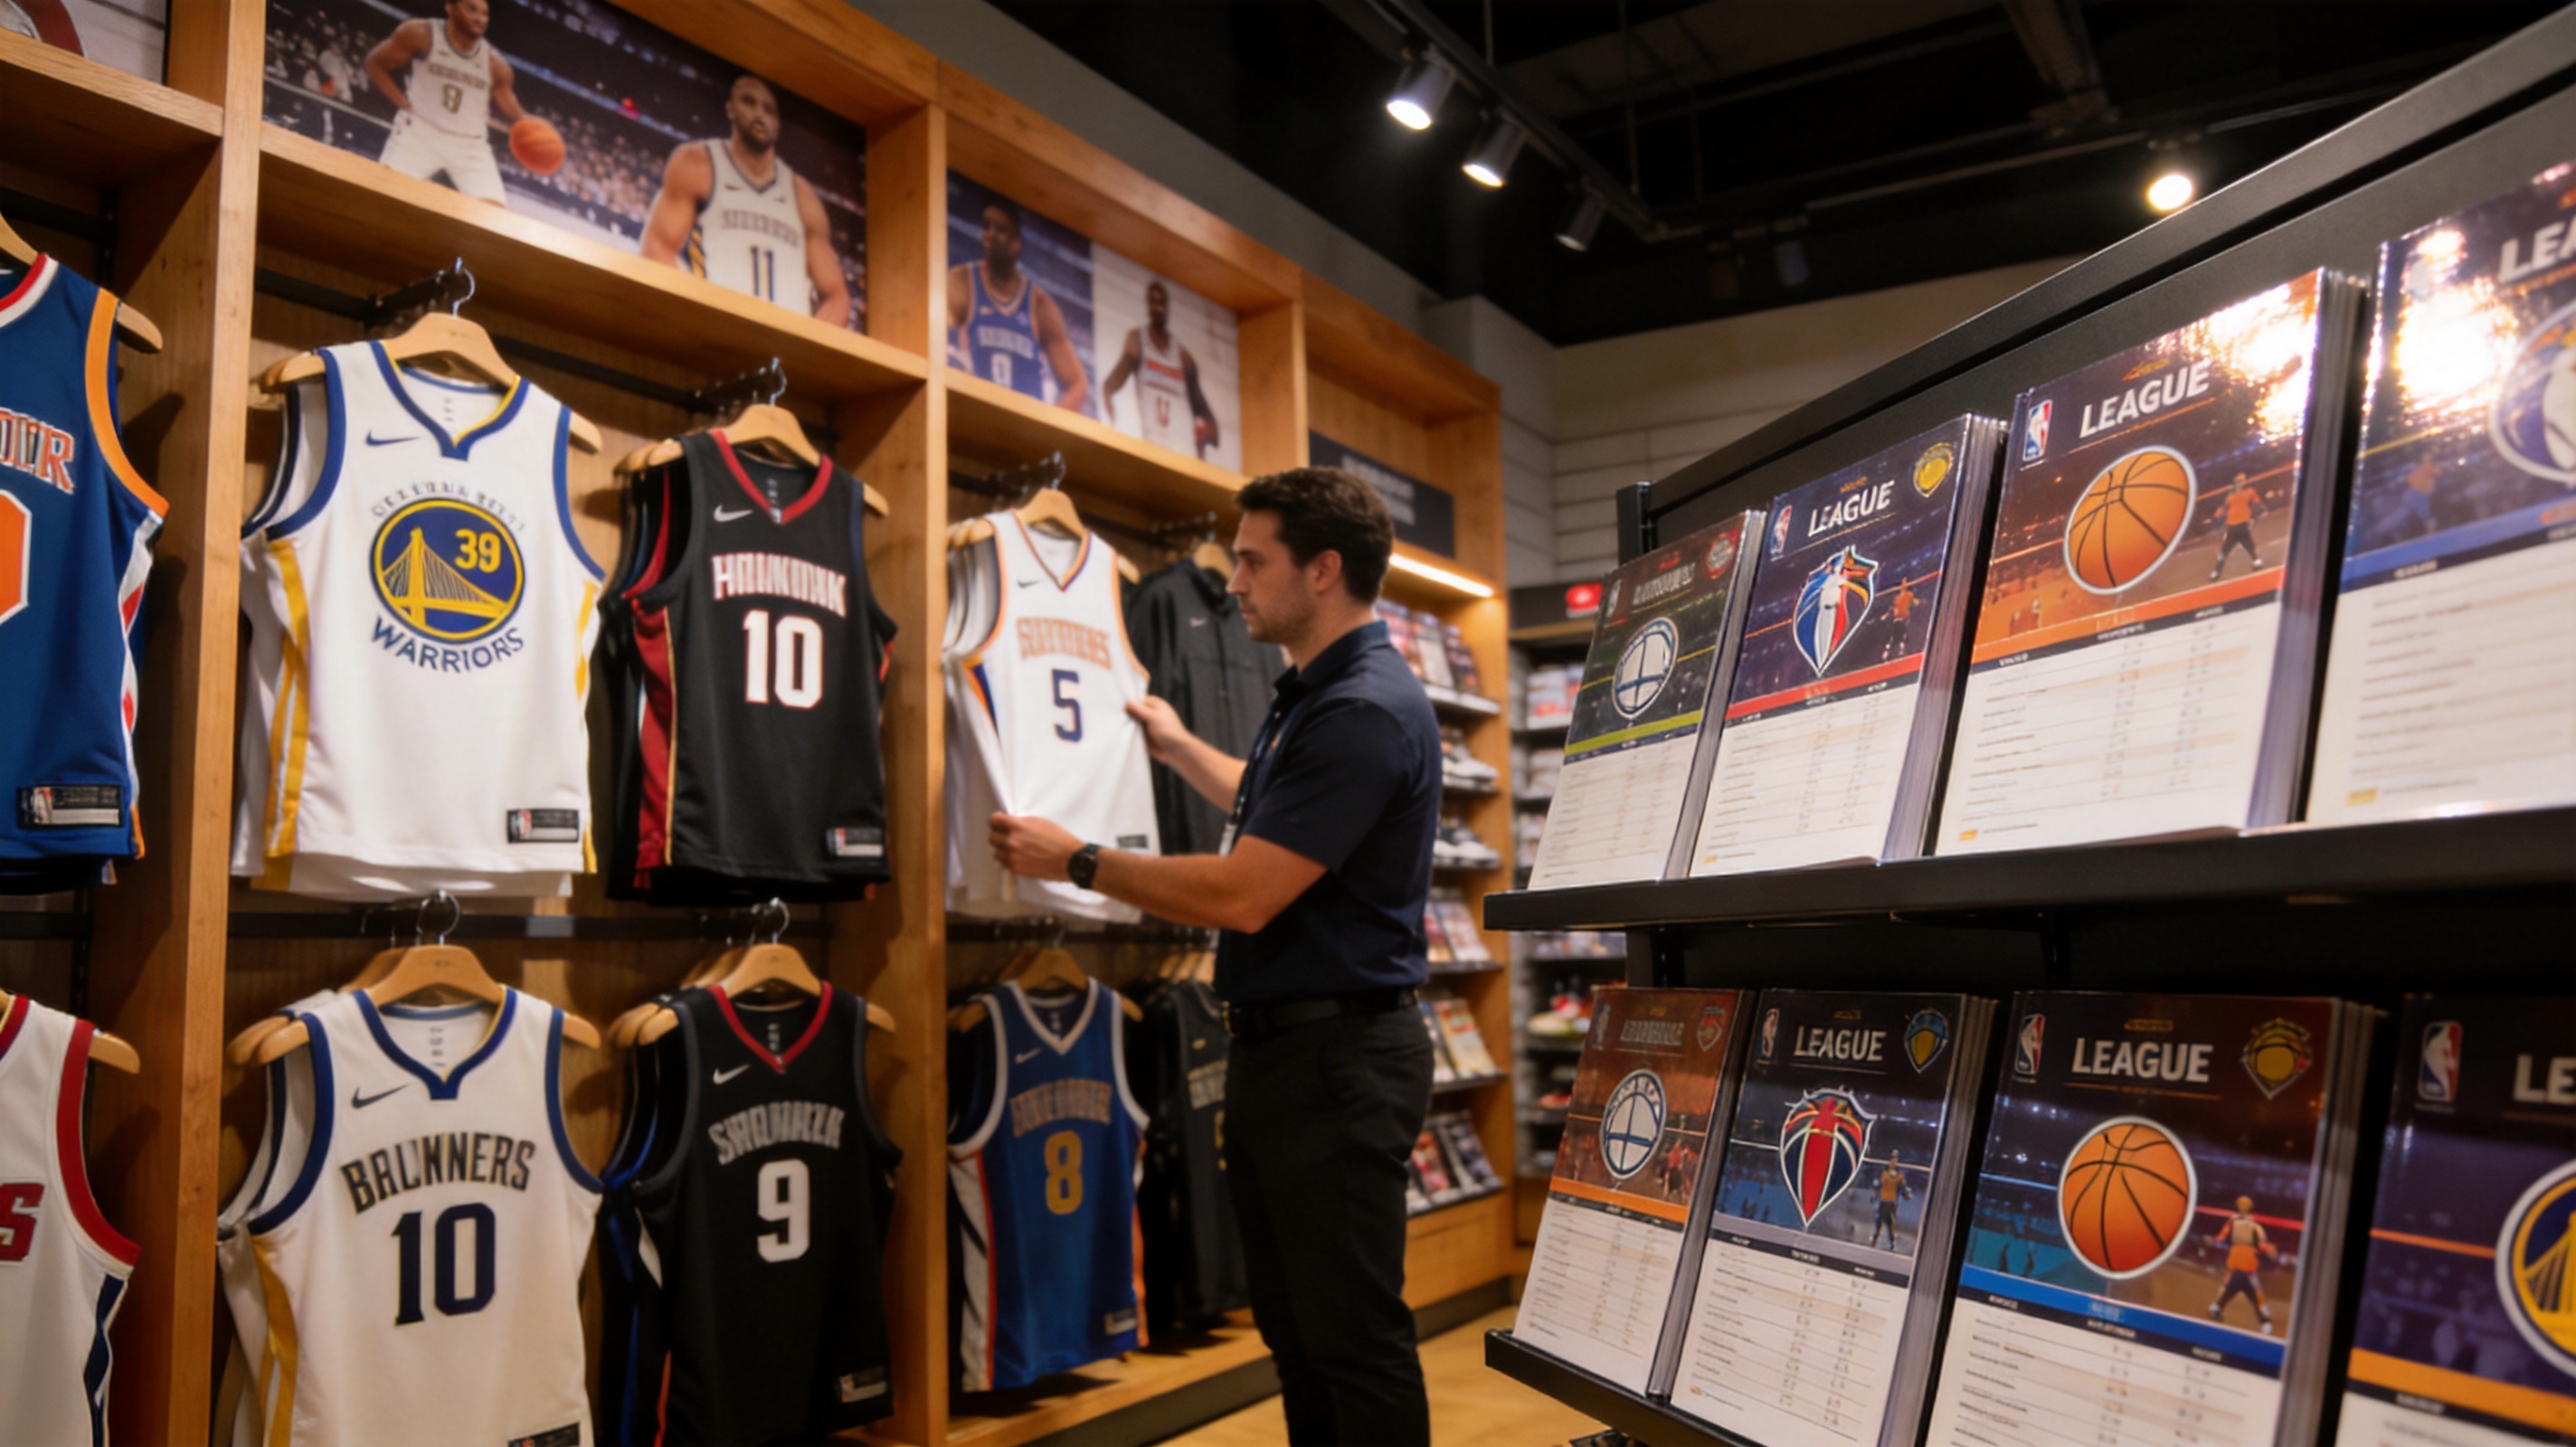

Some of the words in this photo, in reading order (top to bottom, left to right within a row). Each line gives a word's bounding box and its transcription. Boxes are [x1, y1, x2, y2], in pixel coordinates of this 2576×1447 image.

[2079, 359, 2213, 439] LEAGUE
[1807, 479, 1896, 537] LEAGUE
[454, 528, 502, 573] 39
[371, 612, 525, 674] WARRIORS
[743, 609, 824, 710] 10
[1051, 667, 1083, 743] 5
[1794, 1025, 1888, 1062] LEAGUE
[2071, 1037, 2214, 1083] LEAGUE
[1044, 1130, 1084, 1215] 8
[757, 1159, 810, 1263] 9
[390, 1201, 496, 1327] 10
